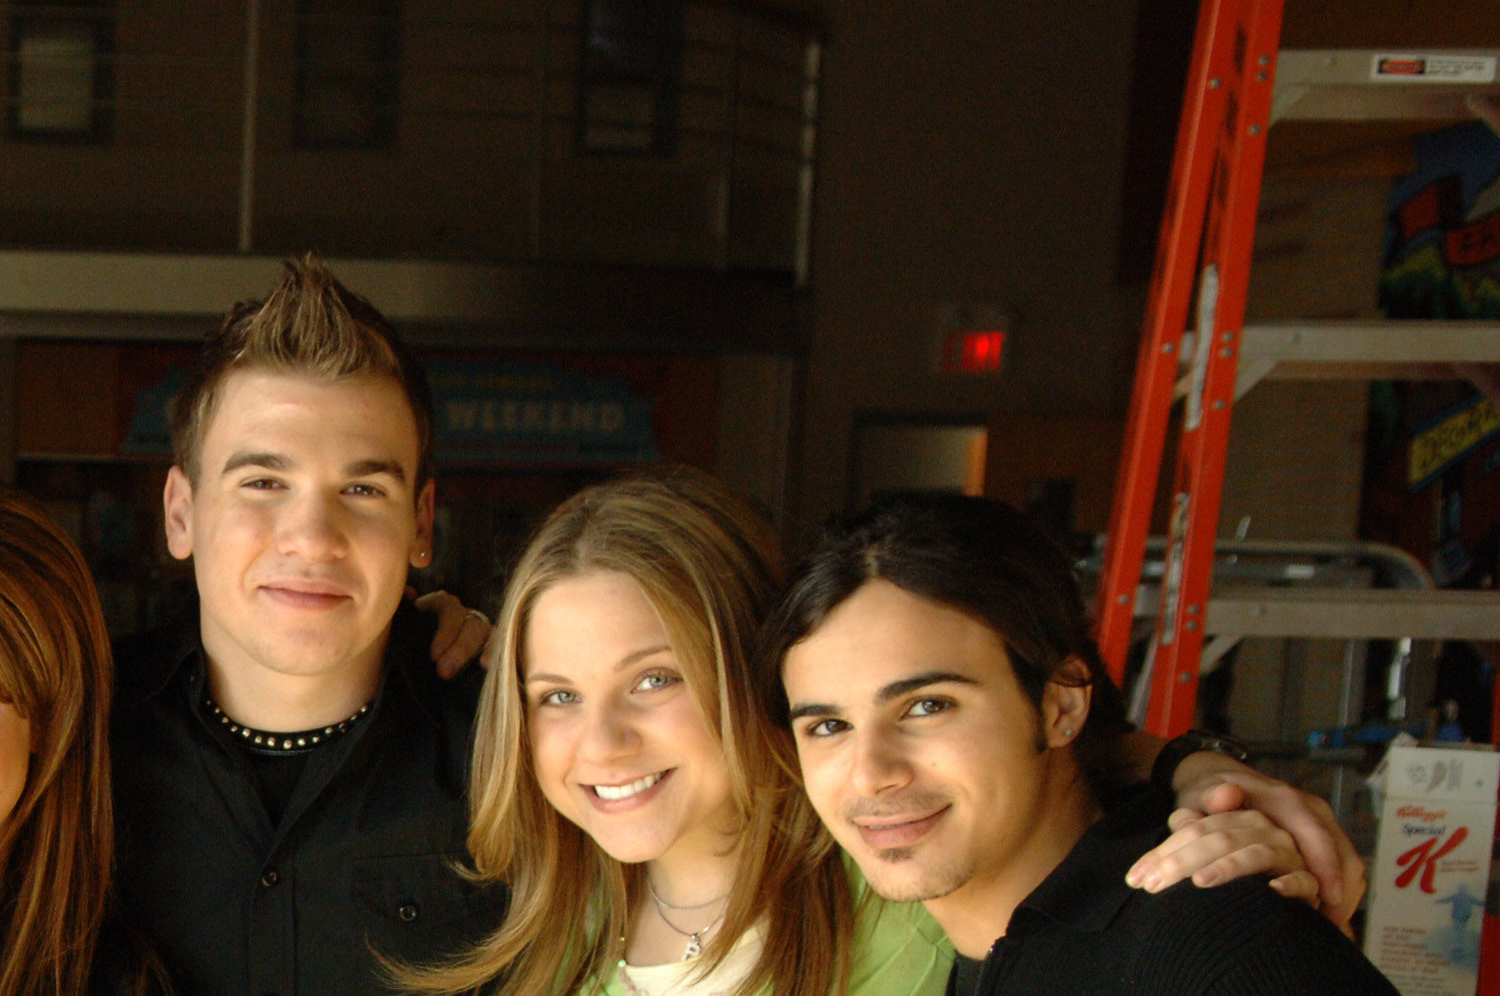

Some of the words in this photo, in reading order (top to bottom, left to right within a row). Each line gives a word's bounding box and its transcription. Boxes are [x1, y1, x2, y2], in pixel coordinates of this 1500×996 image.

[446, 399, 626, 433] WEEKEND
[1403, 824, 1446, 837] Special
[1395, 826, 1468, 894] K
